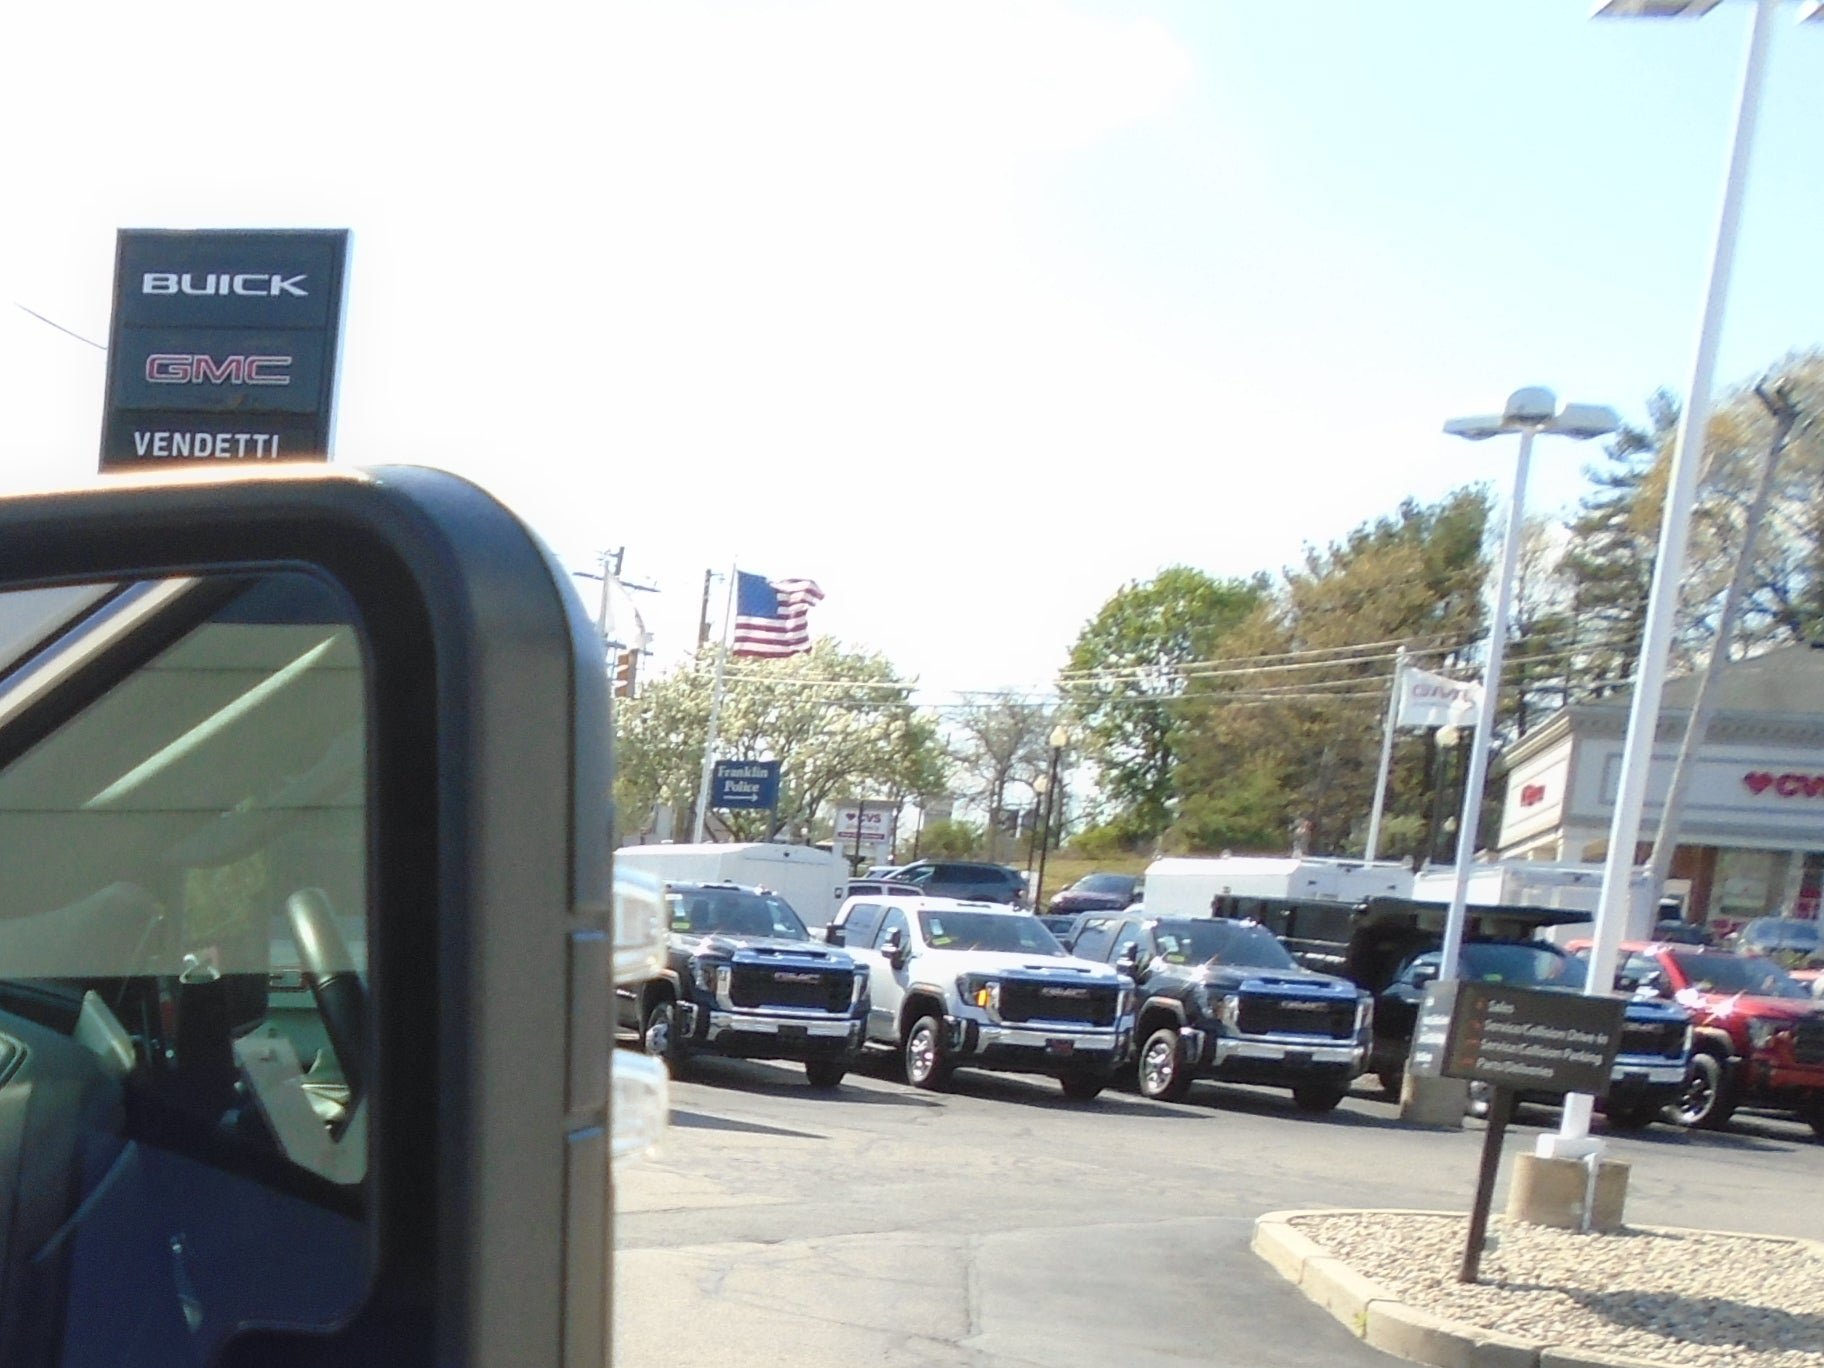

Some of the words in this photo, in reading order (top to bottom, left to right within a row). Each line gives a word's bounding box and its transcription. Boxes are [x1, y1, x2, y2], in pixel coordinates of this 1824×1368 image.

[142, 272, 309, 296] BUICK
[145, 353, 292, 385] GMC
[133, 431, 279, 459] VENDETTI
[717, 765, 769, 779] Franklin
[723, 780, 760, 793] Police
